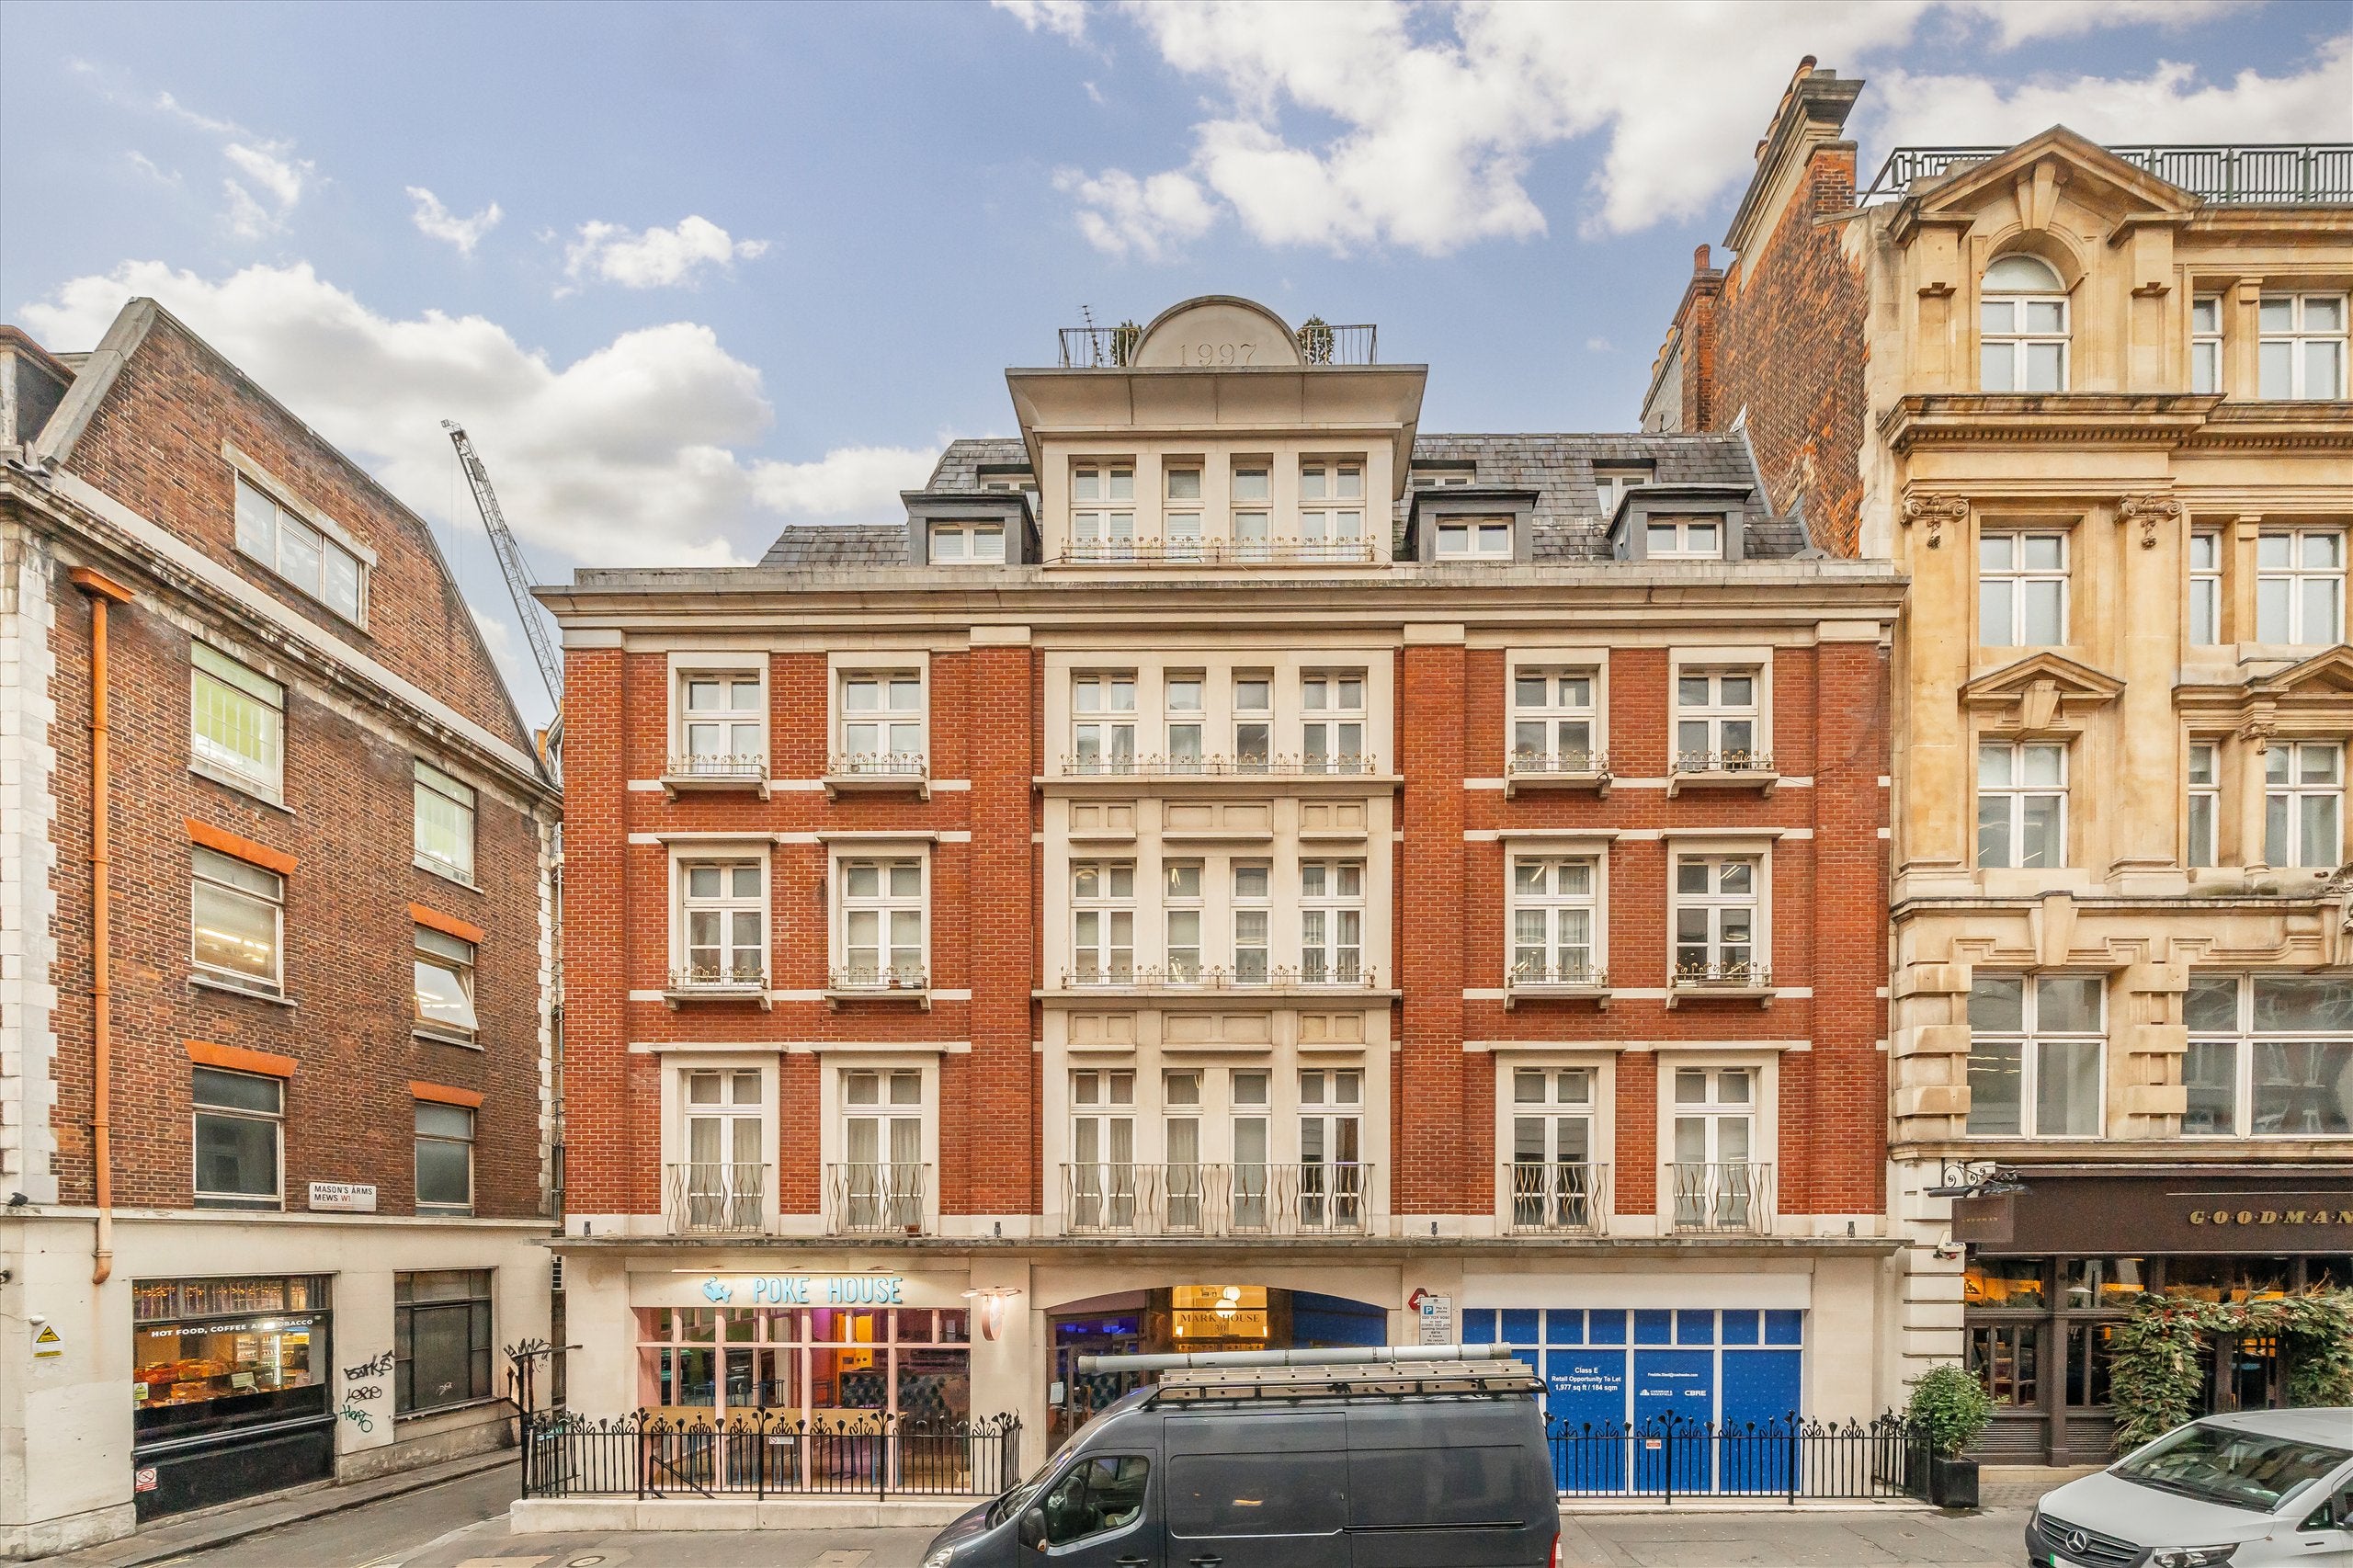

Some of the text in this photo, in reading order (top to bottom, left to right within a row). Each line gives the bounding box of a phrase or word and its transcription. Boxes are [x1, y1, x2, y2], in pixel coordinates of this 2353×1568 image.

[1179, 343, 1257, 367] 1997
[314, 1185, 373, 1195] MASON'S ARMS
[314, 1193, 338, 1202] MEWS
[753, 1277, 904, 1304] POKE HOUSE
[1180, 1313, 1260, 1323] MARK HOUSE
[176, 1327, 208, 1335] FOOD,
[210, 1324, 247, 1334] COFFEE
